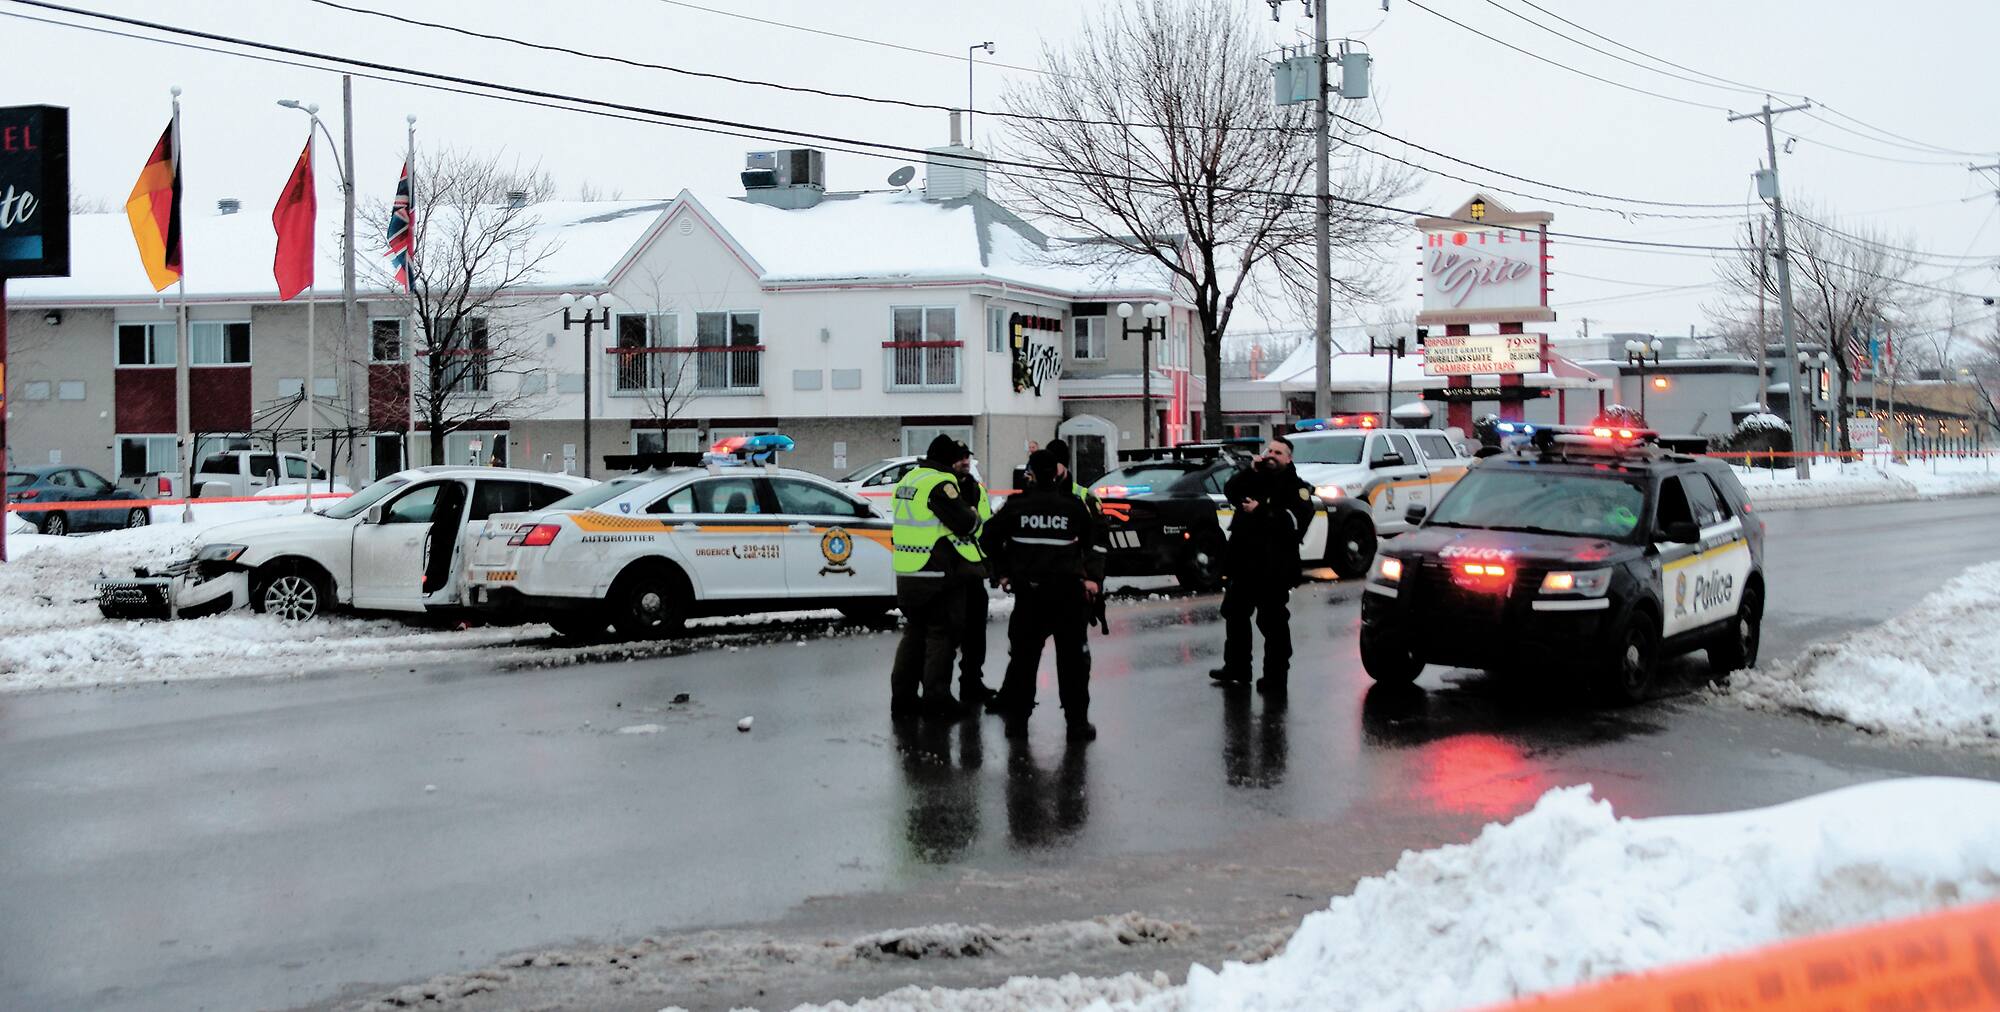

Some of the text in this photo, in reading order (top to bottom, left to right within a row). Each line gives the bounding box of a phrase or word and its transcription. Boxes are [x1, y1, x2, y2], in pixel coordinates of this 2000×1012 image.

[0, 184, 39, 229] te
[1428, 230, 1533, 247] HOTEL
[1429, 250, 1460, 276] Le
[1434, 363, 1471, 373] CHAMBRE
[1020, 515, 1069, 530] POLICE
[581, 534, 656, 543] AUTOROUTIER
[696, 548, 731, 556] URGENCE
[1693, 569, 1733, 612] Police
